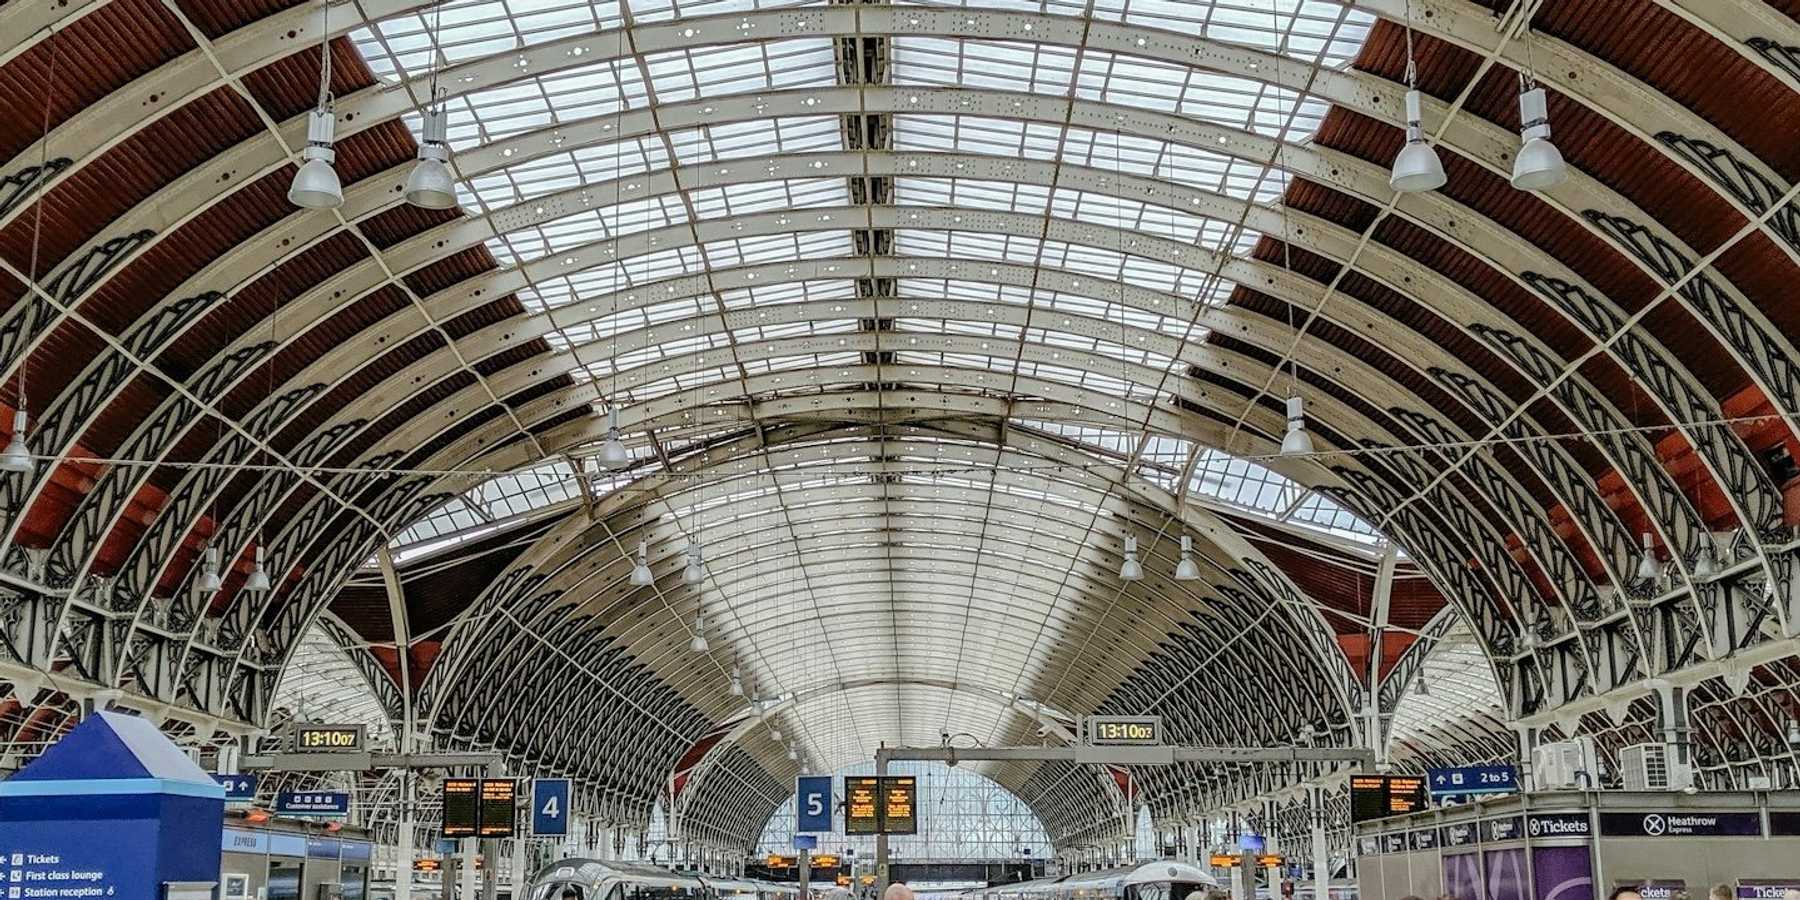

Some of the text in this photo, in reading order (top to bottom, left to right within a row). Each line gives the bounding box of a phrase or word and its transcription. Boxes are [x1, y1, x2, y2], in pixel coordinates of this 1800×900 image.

[1480, 772, 1509, 782] 2 to 5
[542, 796, 560, 819] 4
[807, 793, 823, 816] 5
[1541, 819, 1588, 833] Tickets
[1667, 816, 1716, 826] Heathrow
[27, 855, 59, 864] Tickets
[26, 870, 103, 882] First class lounge
[24, 887, 103, 898] Station reception
[1640, 887, 1671, 898] ckets
